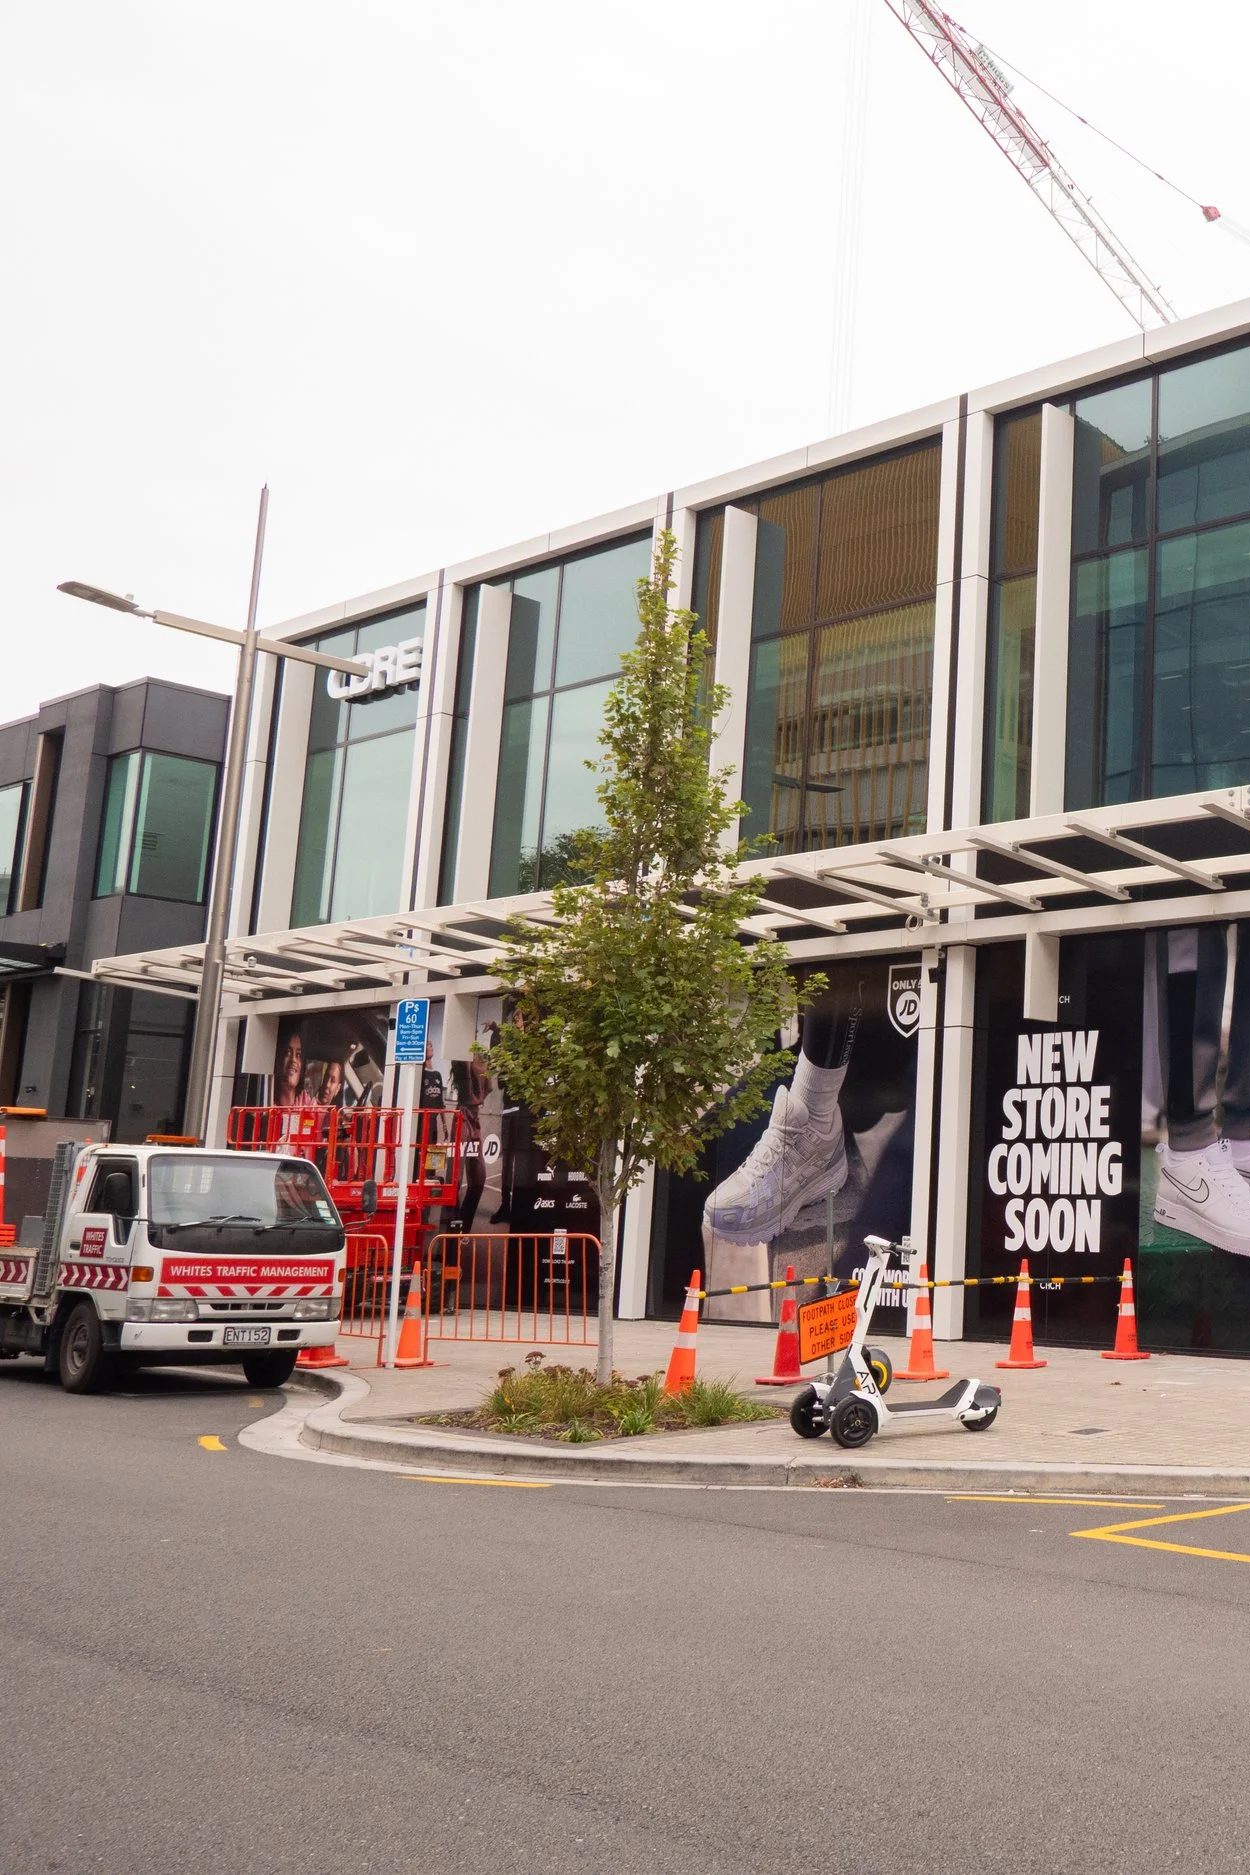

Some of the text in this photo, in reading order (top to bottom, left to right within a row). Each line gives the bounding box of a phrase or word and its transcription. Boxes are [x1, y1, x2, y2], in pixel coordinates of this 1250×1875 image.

[892, 980, 917, 991] ONLY
[900, 999, 918, 1017] JD
[406, 1013, 417, 1024] 60
[1016, 1030, 1100, 1085] NEW
[1002, 1085, 1111, 1140] STORE
[466, 1141, 480, 1153] AT
[987, 1141, 1123, 1196] COMING
[1004, 1197, 1102, 1253] SOON
[85, 1231, 105, 1242] WHITES
[83, 1243, 103, 1255] TRAFFIC
[170, 1265, 329, 1278] WHITES TRAFFIC MANAGEMENT
[883, 1269, 909, 1284] WOR
[802, 1294, 857, 1321] FOOTPATH CLOSE
[808, 1312, 856, 1338] PLEASE USE
[226, 1330, 268, 1342] ENT152
[811, 1336, 835, 1355] OTHER
